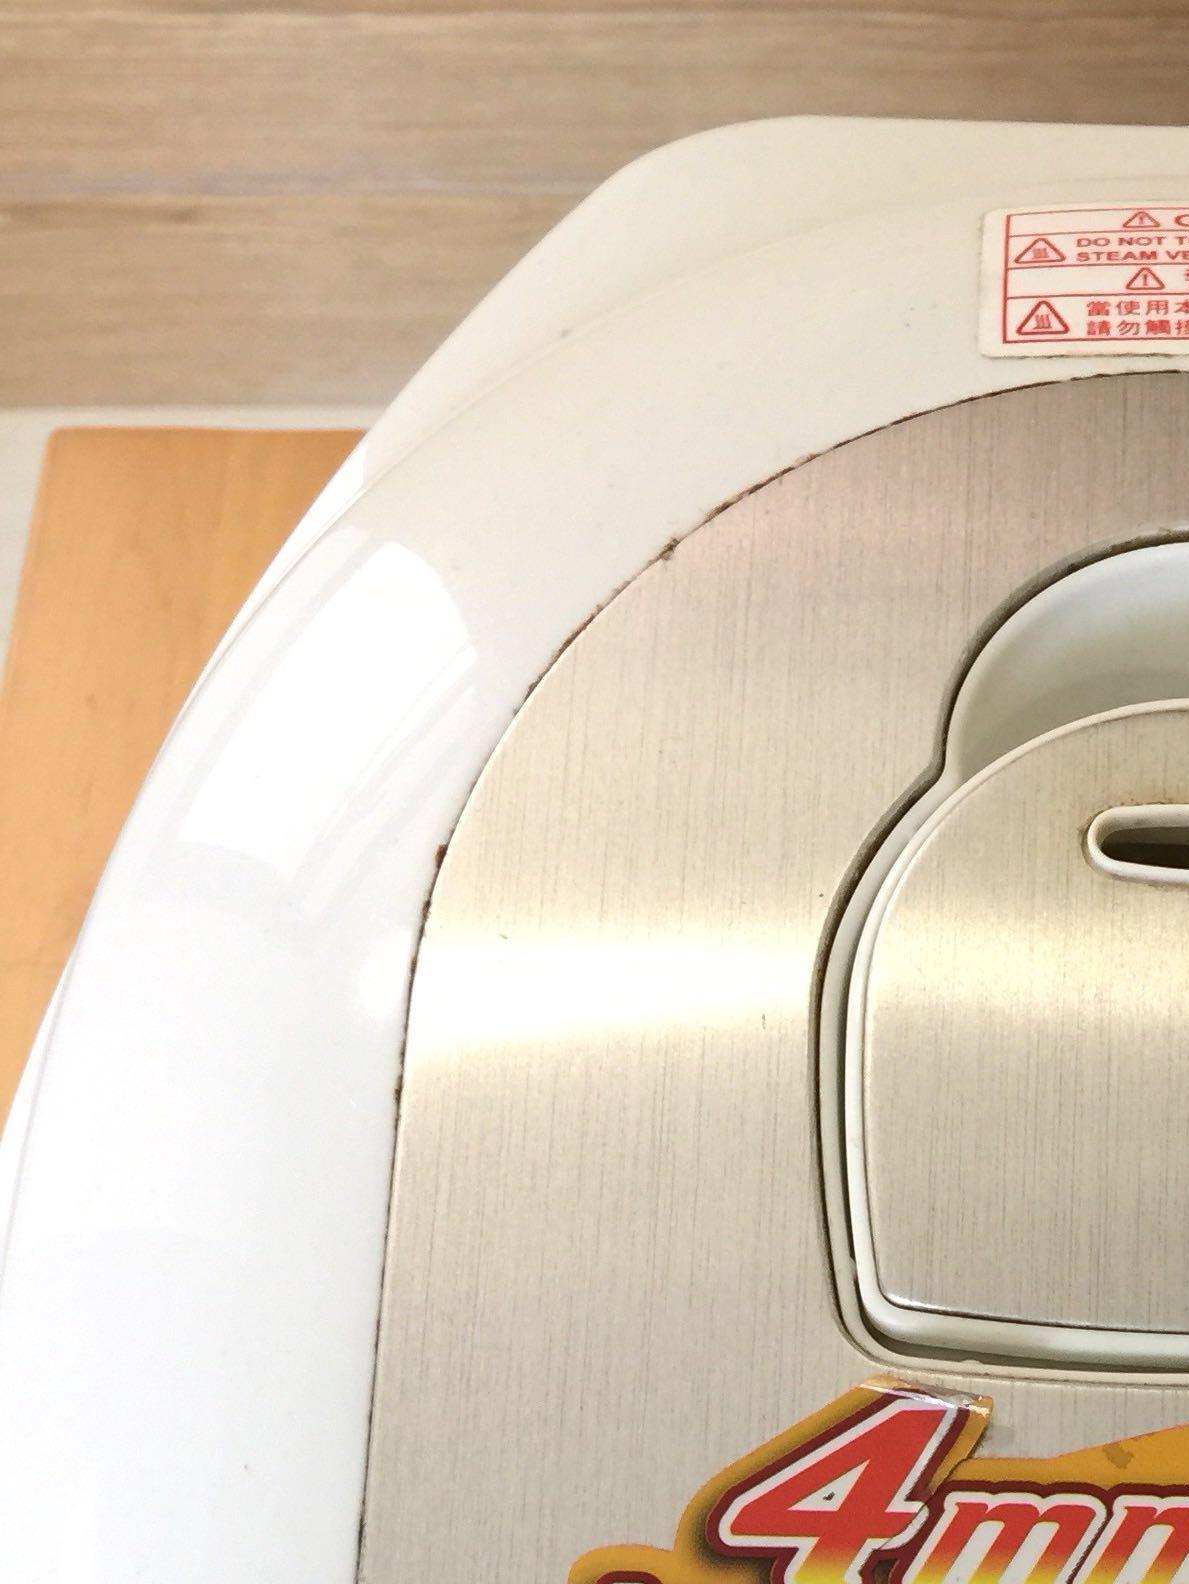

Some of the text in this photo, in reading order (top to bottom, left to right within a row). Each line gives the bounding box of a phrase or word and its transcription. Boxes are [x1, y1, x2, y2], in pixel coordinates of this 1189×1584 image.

[1075, 236, 1112, 248] DO
[1118, 235, 1168, 248] NOT
[1075, 250, 1158, 262] STEAM
